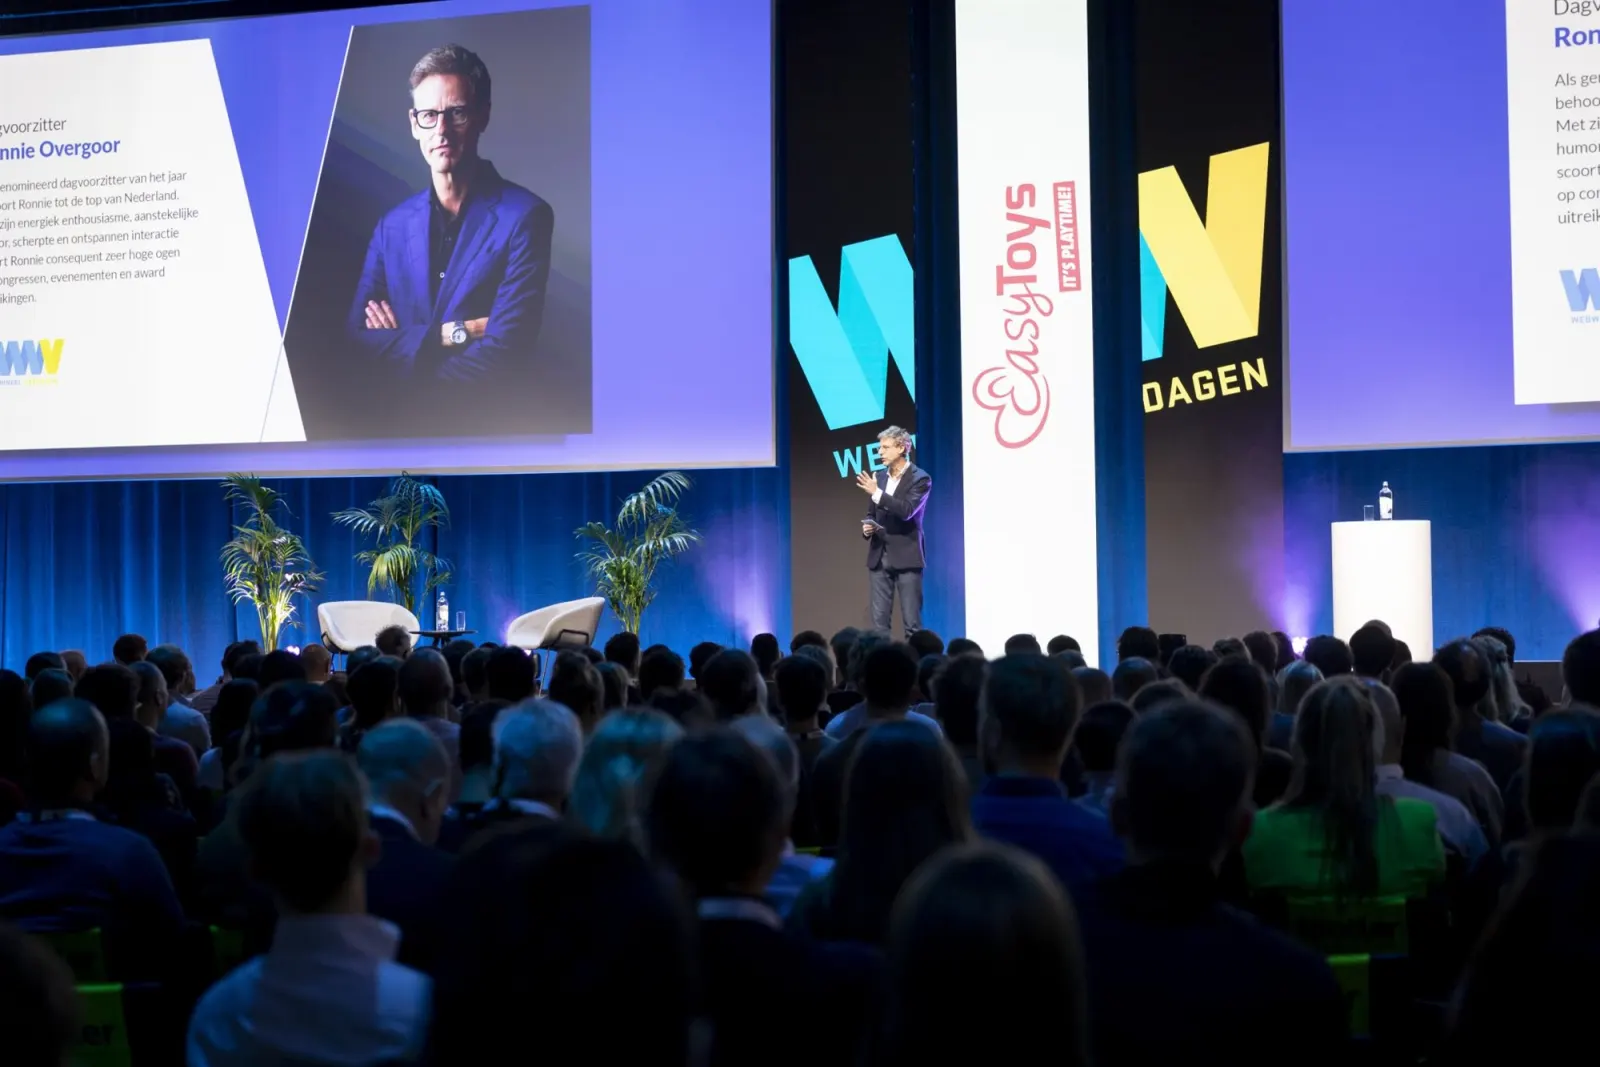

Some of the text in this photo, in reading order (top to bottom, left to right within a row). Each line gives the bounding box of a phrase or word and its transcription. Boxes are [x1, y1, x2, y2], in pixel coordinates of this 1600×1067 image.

[1554, 73, 1600, 87] Als ge
[1556, 118, 1585, 133] Met
[0, 140, 121, 161] nnie Overgoor
[1556, 141, 1600, 156] humo
[0, 170, 188, 192] enomineerd dagvoorzitter van het jaar
[0, 189, 180, 211] ort Ronnie tot de top van Nederland.
[1557, 190, 1576, 204] op
[17, 216, 59, 230] energiek
[62, 211, 133, 226] enthousiasme,
[134, 207, 199, 222] aanstekelijke
[12, 234, 55, 249] scherpte
[56, 236, 69, 246] en
[71, 230, 129, 246] ontspannen
[131, 227, 180, 242] interactie
[1057, 186, 1077, 289] IT'S PLAYTIME!
[10, 254, 44, 267] Ronnie
[46, 250, 103, 265] consequent
[105, 252, 127, 263] zeer
[128, 247, 154, 263] hoge
[155, 247, 181, 261] ogen
[50, 269, 118, 284] evenementen
[119, 271, 132, 281] en
[134, 266, 166, 280] award
[972, 183, 1054, 449] EasyToys
[1142, 357, 1269, 413] DAGEN
